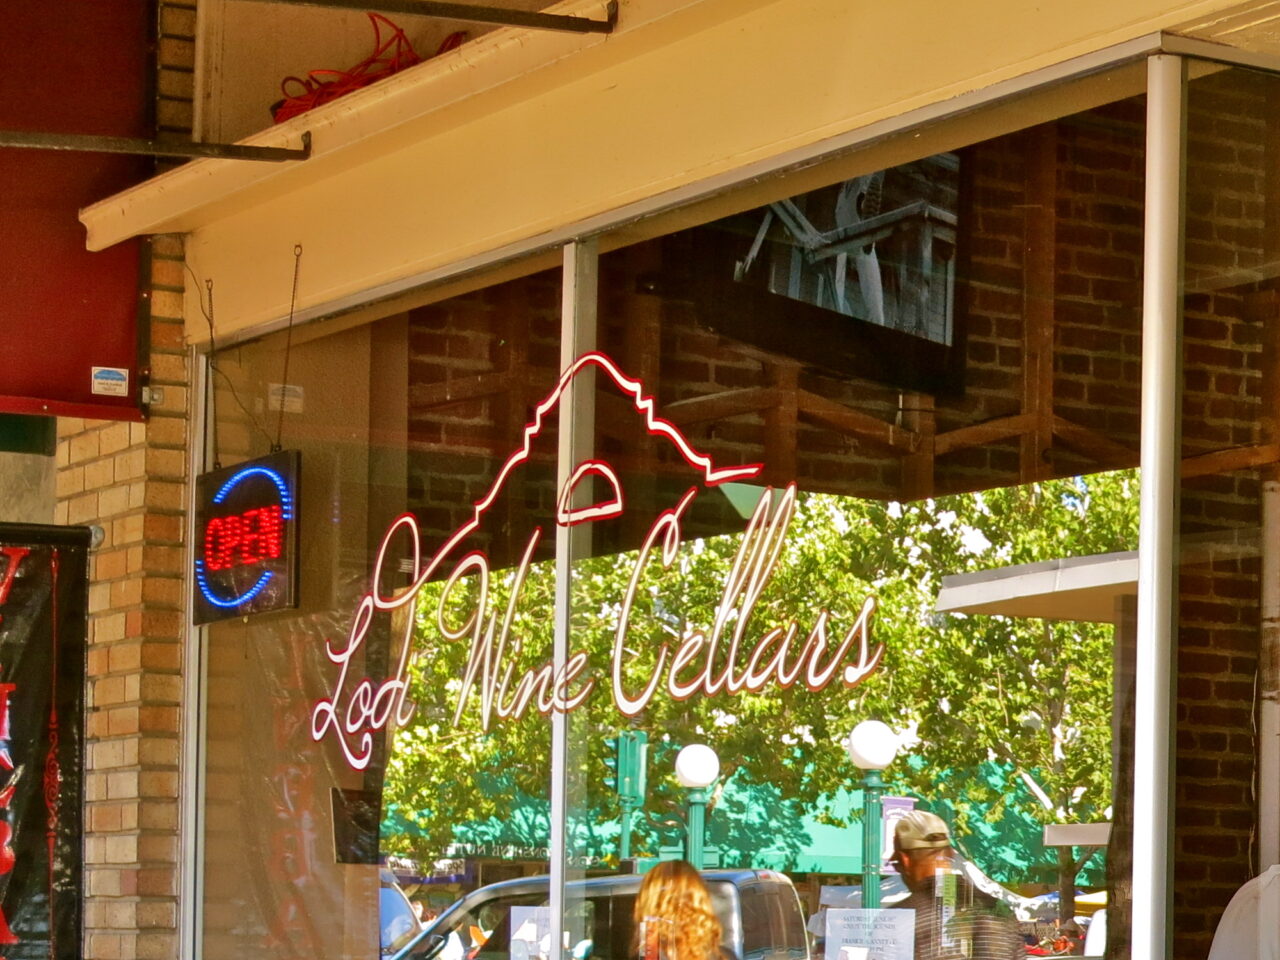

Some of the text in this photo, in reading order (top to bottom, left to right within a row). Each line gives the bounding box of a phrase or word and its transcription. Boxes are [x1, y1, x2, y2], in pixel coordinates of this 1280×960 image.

[205, 504, 282, 571] OPEN
[438, 528, 595, 732] Wine
[611, 482, 885, 716] Cellars
